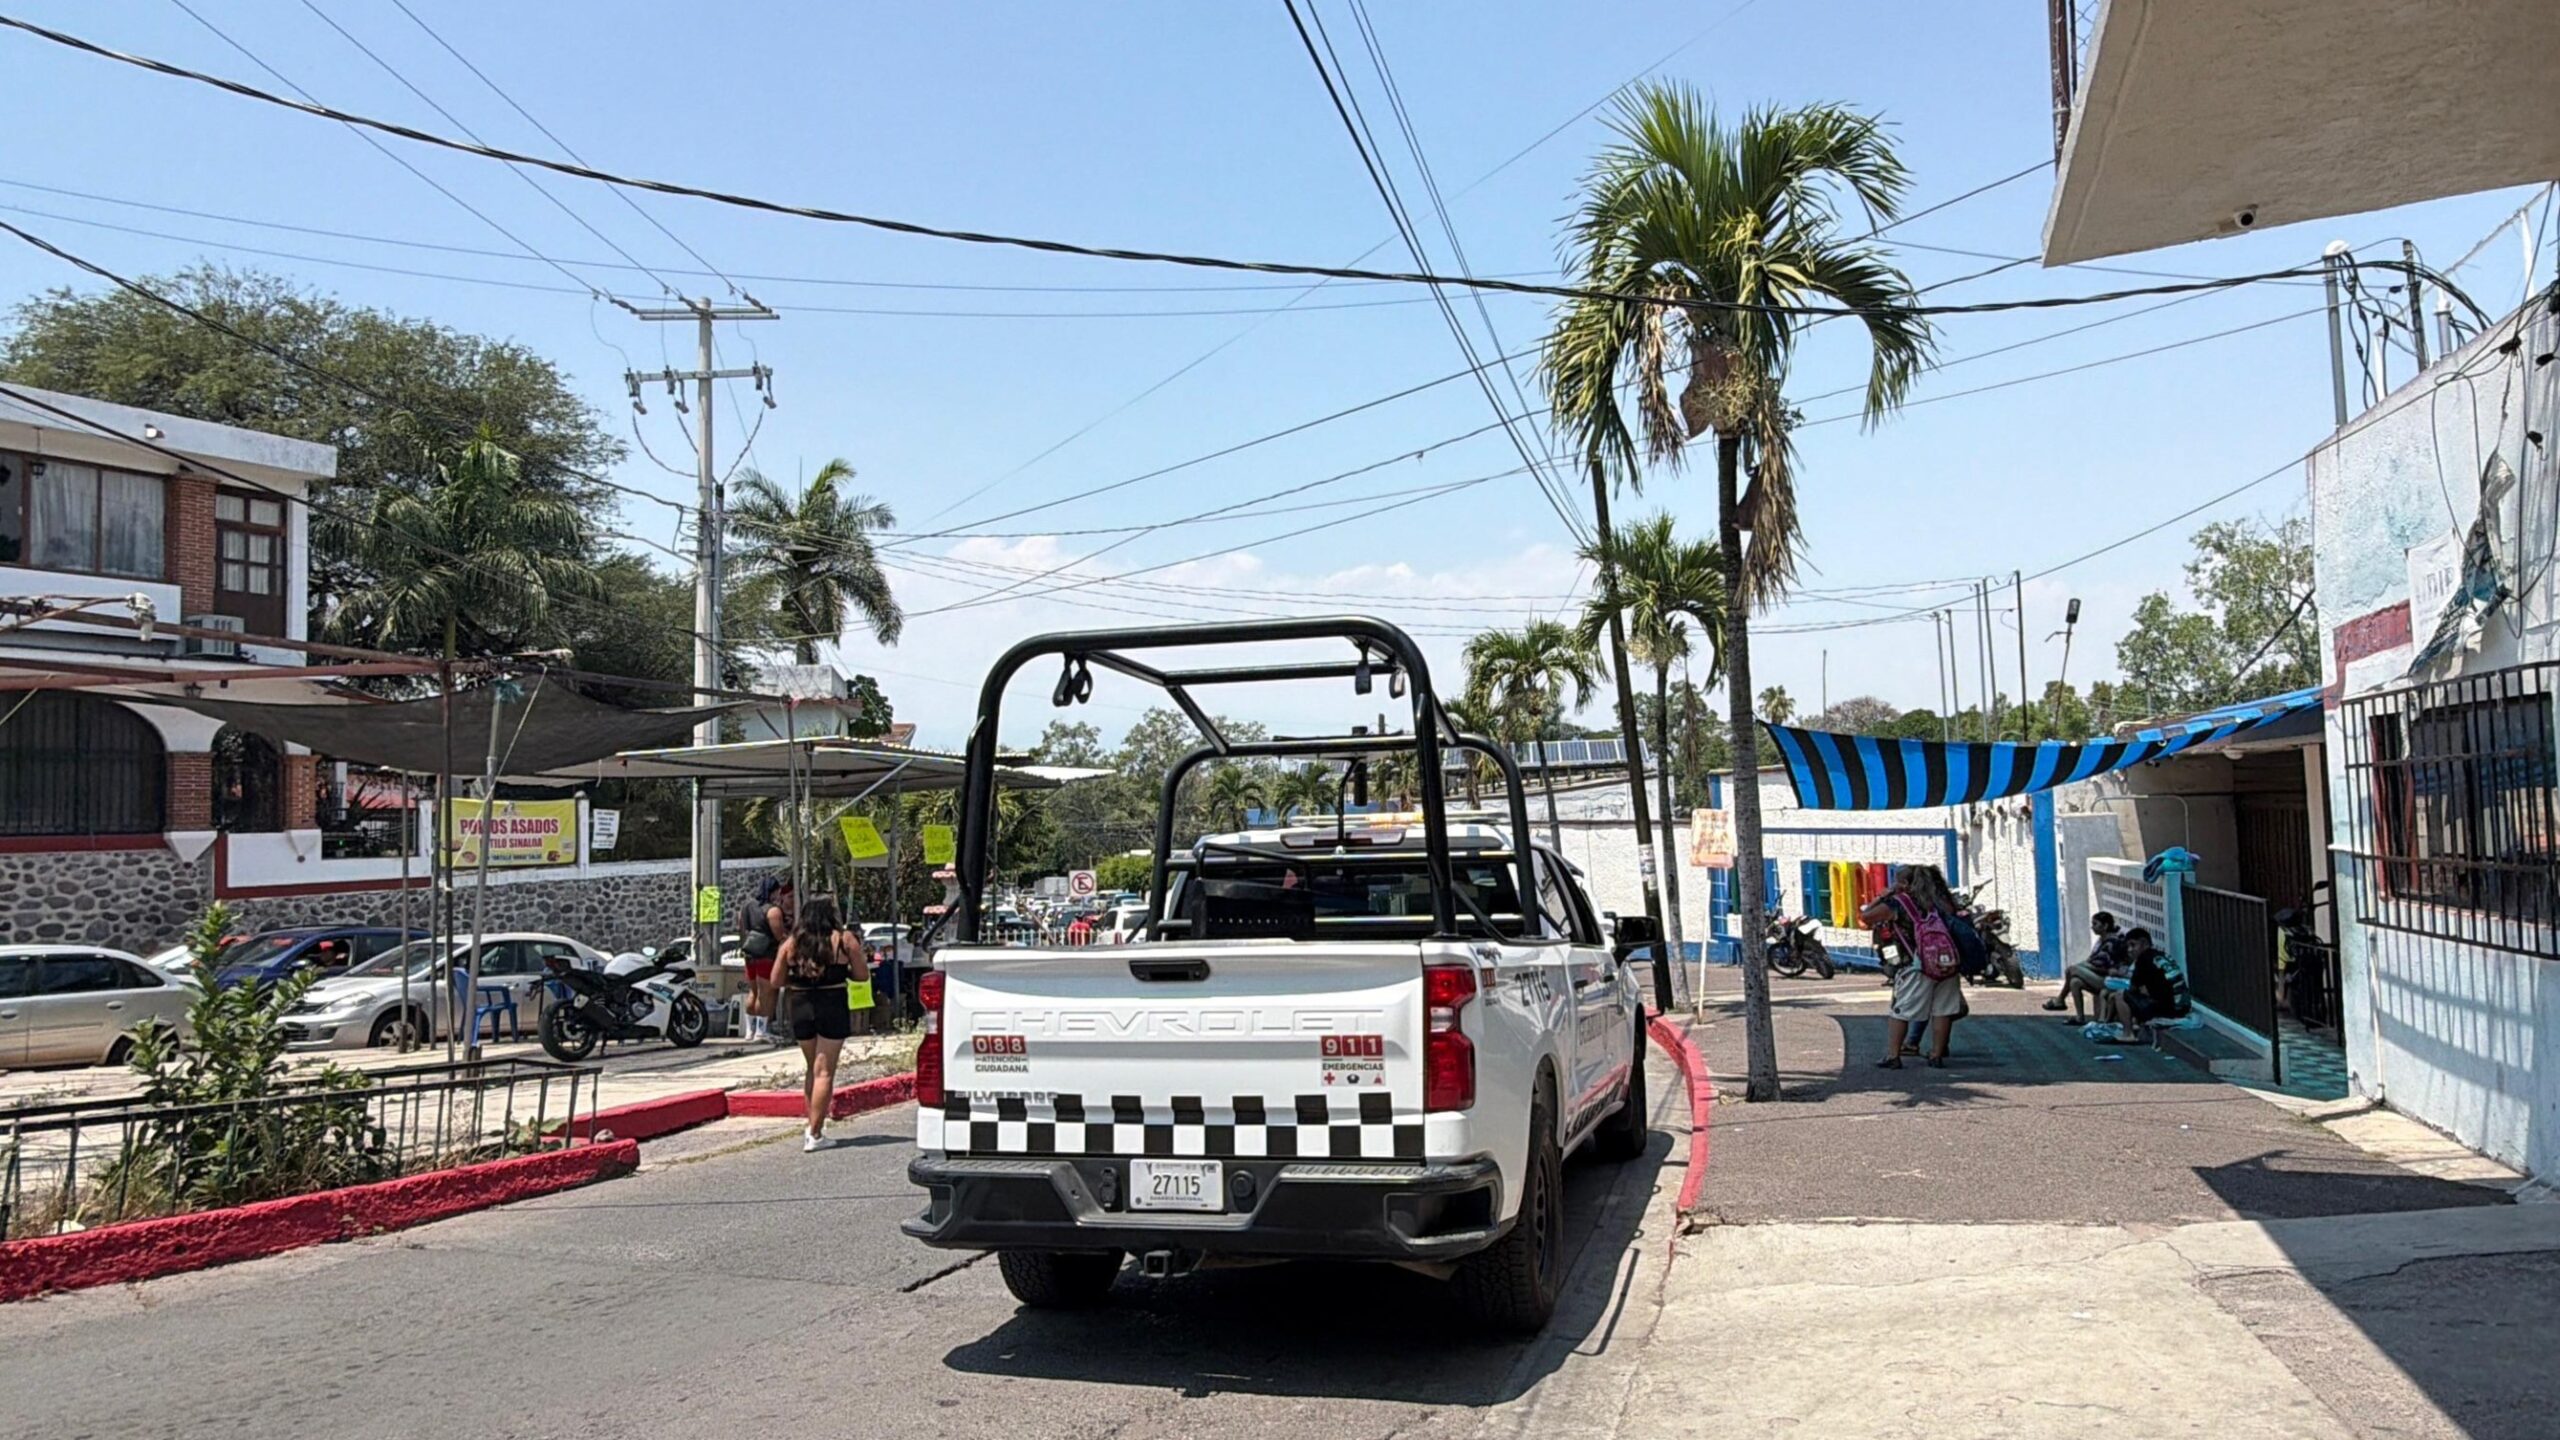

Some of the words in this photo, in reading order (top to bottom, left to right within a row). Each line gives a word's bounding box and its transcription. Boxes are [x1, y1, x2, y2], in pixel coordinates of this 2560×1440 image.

[460, 819, 508, 835] POLOS
[511, 818, 559, 834] ASADOS
[509, 838, 543, 848] SINALOA
[1515, 970, 1551, 1007] 27115
[970, 1010, 1383, 1036] CHEVROLET
[976, 1037, 1022, 1052] 088
[1325, 1038, 1377, 1054] 911
[975, 1064, 1029, 1073] CIUDADANA
[1322, 1063, 1384, 1071] EMERGENCIAS
[1153, 1175, 1201, 1196] 27115
